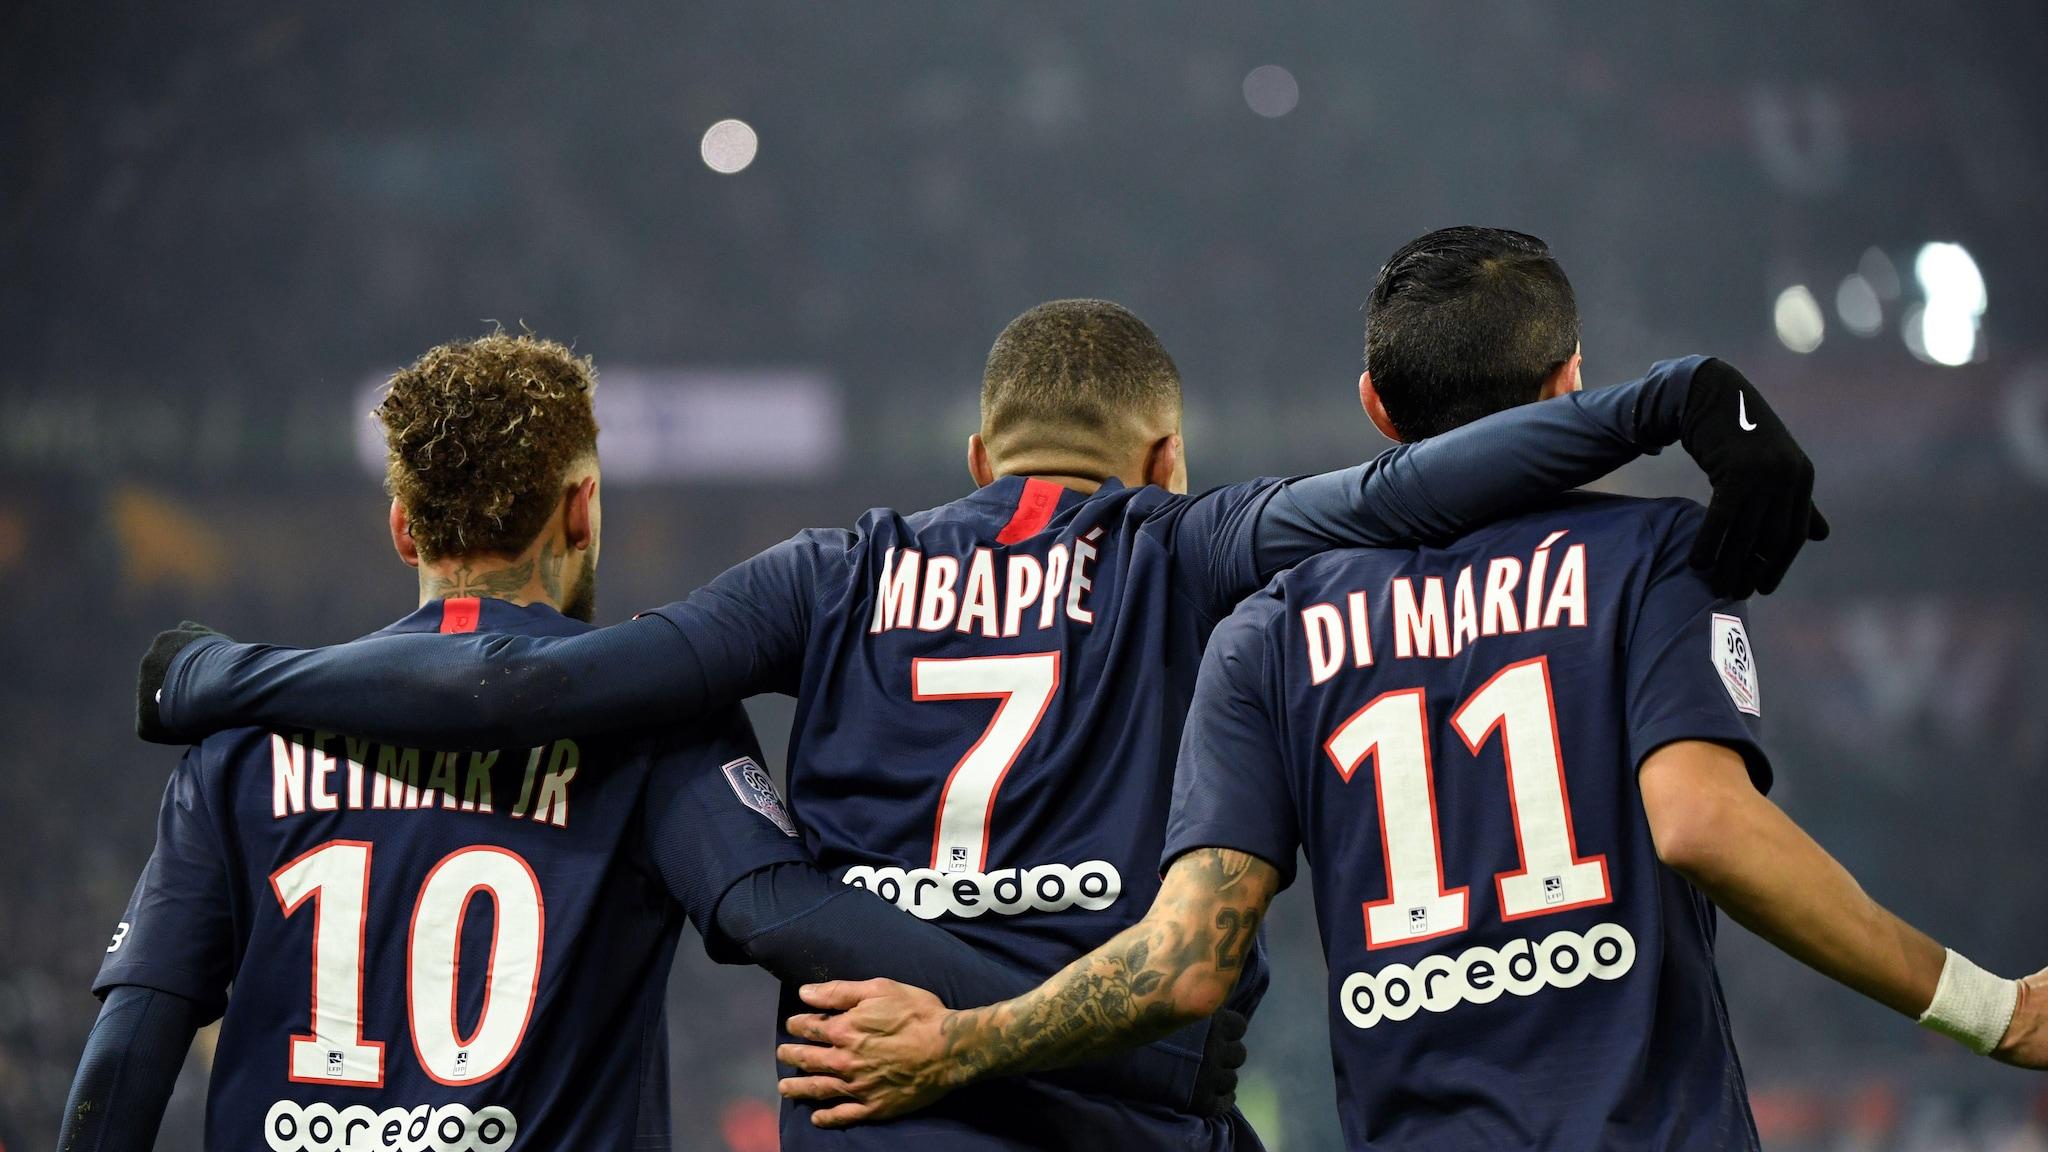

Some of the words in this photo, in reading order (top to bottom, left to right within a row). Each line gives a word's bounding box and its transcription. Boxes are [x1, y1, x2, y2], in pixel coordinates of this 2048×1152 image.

[868, 526, 1104, 639] MBAPPÉ
[1301, 590, 1374, 686] DI
[1391, 530, 1588, 659] MARÍA
[271, 730, 500, 820] NEYMAR
[510, 738, 581, 829] JR
[911, 651, 1061, 873] 7
[1323, 655, 1613, 951] 11
[268, 839, 545, 1087] 10
[1349, 933, 1625, 1017] ooredoo
[272, 1103, 509, 1148] ooredoo
